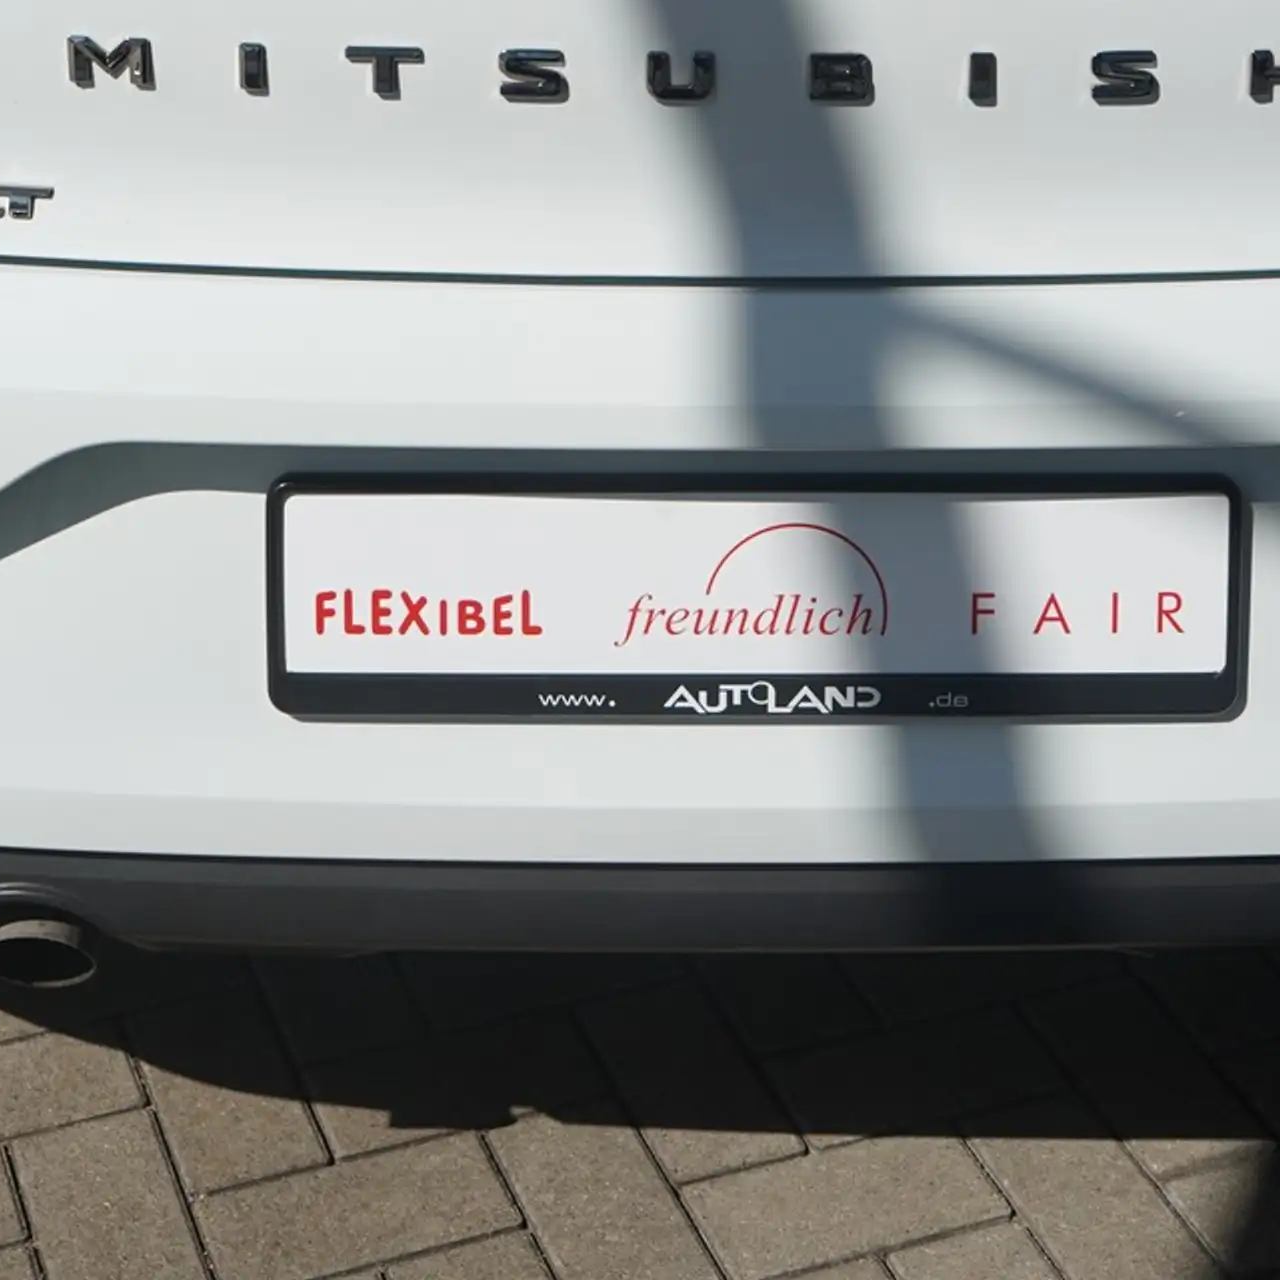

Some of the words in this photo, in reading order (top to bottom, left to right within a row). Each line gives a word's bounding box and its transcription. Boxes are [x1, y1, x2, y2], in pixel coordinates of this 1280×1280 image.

[314, 587, 544, 637] FLEXIBEL
[614, 590, 875, 647] freundlich
[972, 590, 1186, 635] FAIR
[538, 692, 616, 708] www.
[663, 680, 882, 714] AUTOLAND
[928, 692, 970, 708] .de
